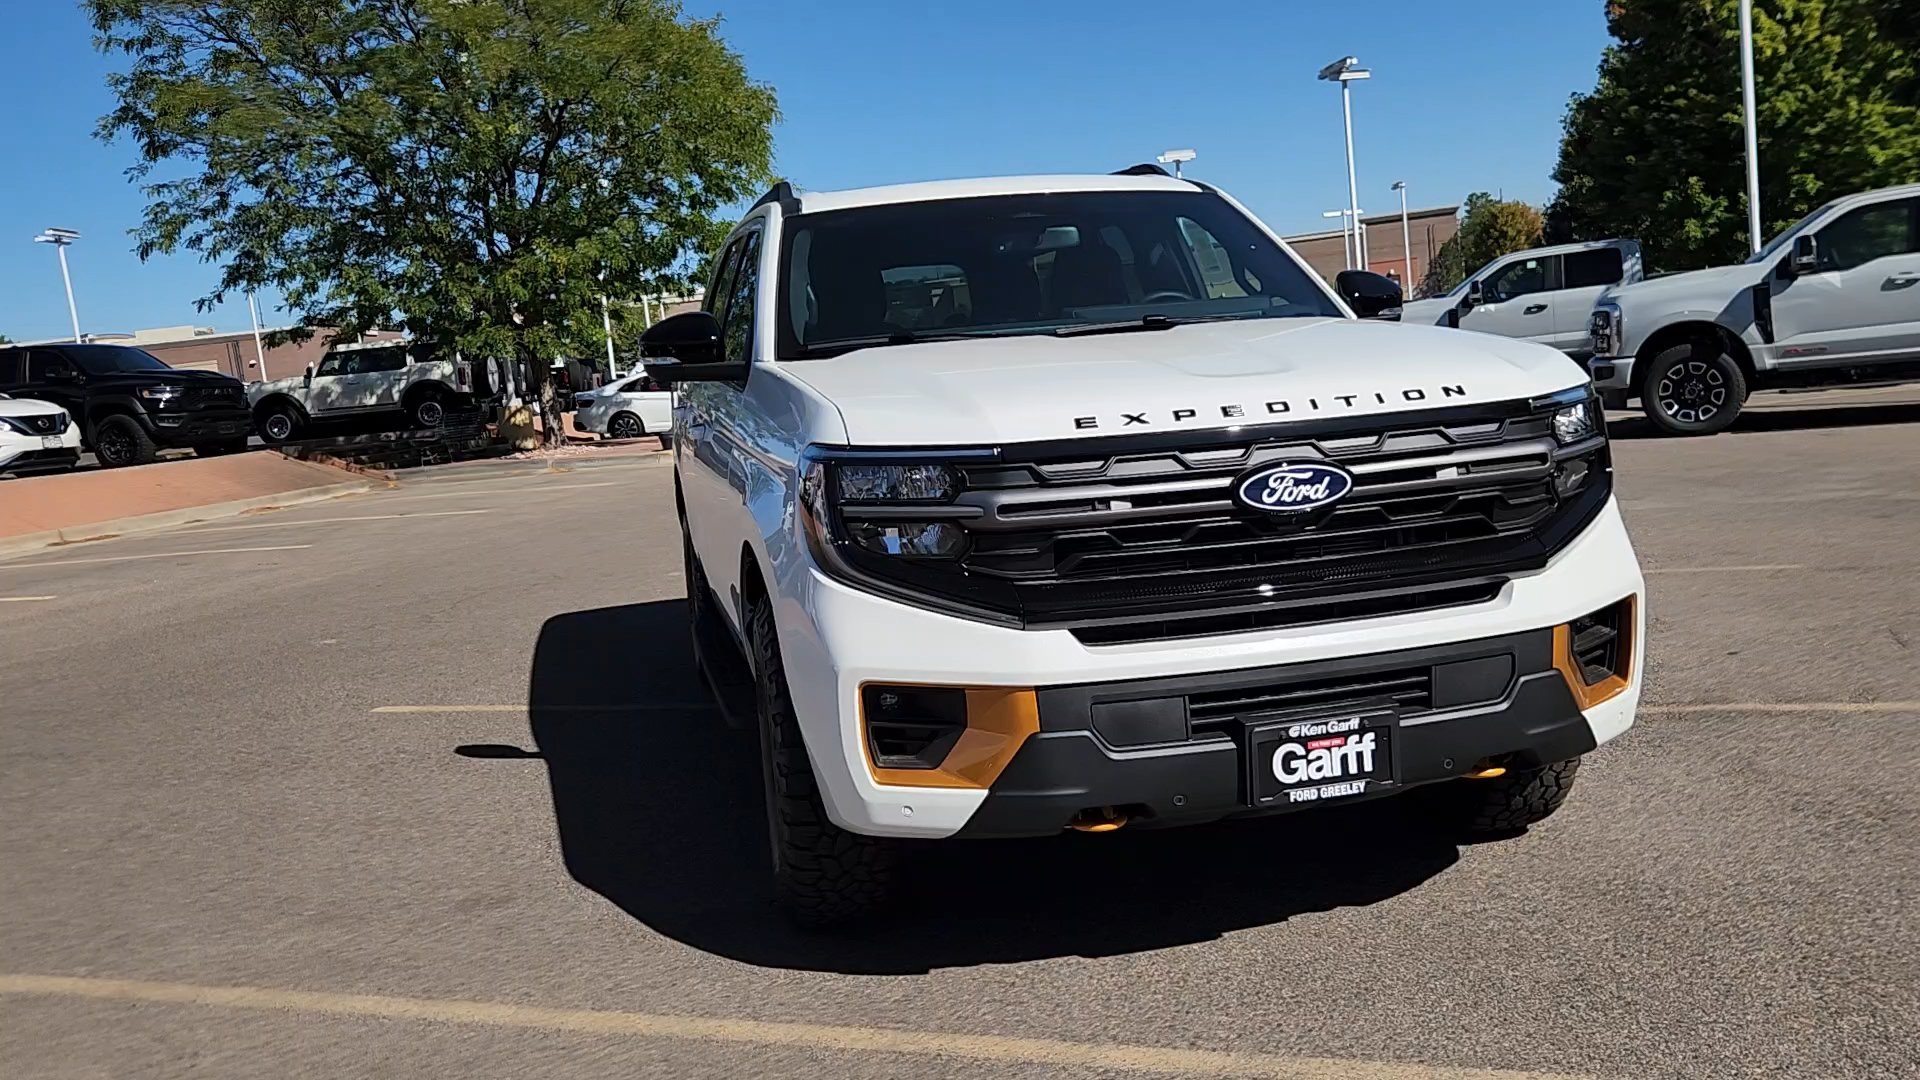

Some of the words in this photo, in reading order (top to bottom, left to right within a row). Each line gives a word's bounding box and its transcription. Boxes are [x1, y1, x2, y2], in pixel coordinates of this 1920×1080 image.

[1074, 384, 1467, 430] EXPEDITION
[1261, 470, 1332, 504] Ford
[1272, 731, 1376, 784] Garff
[1289, 789, 1318, 803] FORD
[1319, 781, 1366, 798] GREELEY
